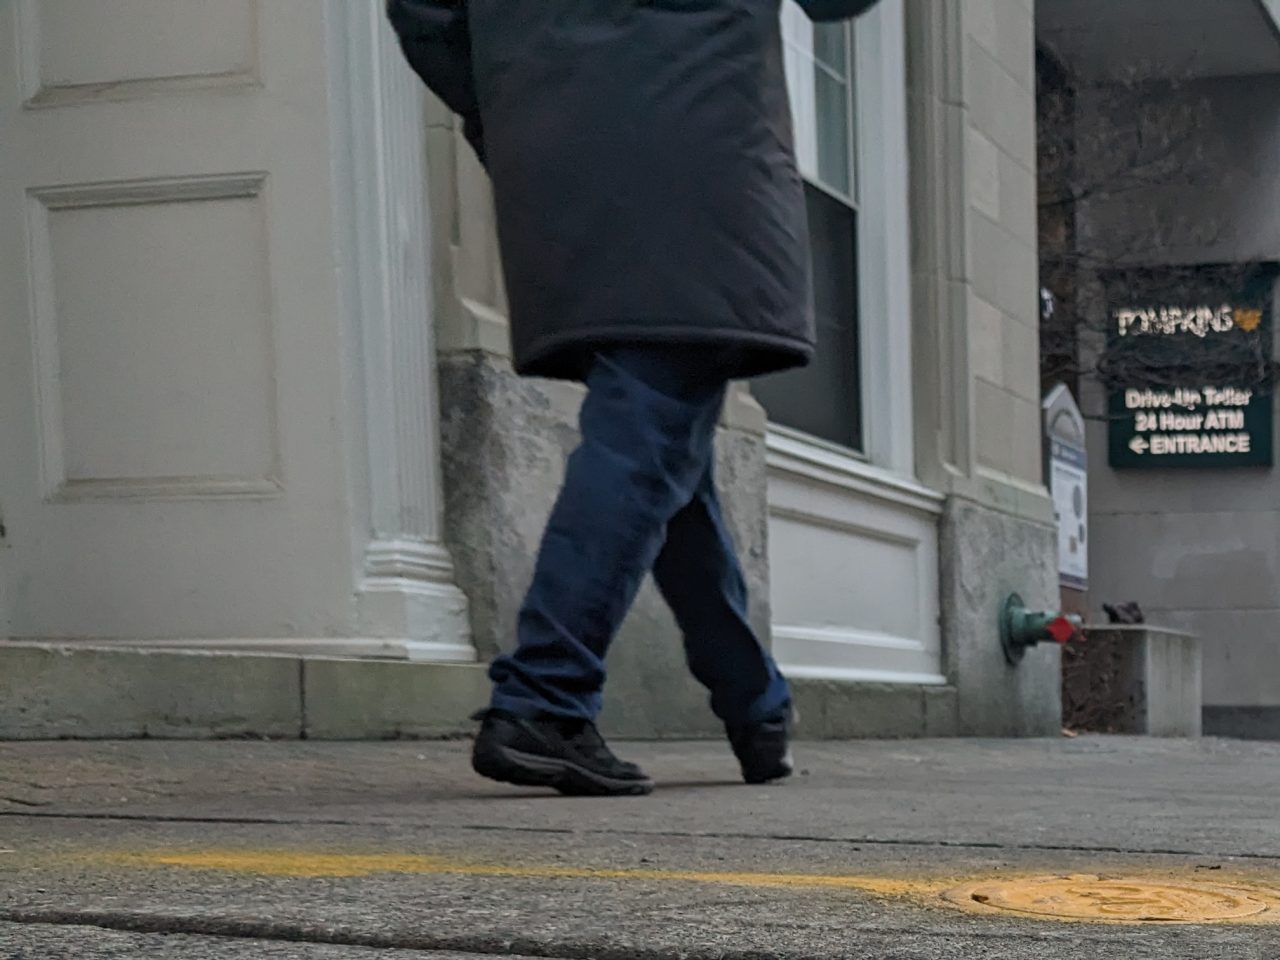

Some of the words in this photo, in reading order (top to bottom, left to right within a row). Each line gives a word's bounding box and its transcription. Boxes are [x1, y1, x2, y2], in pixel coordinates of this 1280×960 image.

[1125, 387, 1202, 411] Drive-Up
[1202, 385, 1253, 406] Teller
[1134, 410, 1157, 432] 24
[1159, 410, 1203, 431] Hour
[1203, 408, 1245, 430] ATM
[1149, 432, 1251, 455] ENTRANCE
